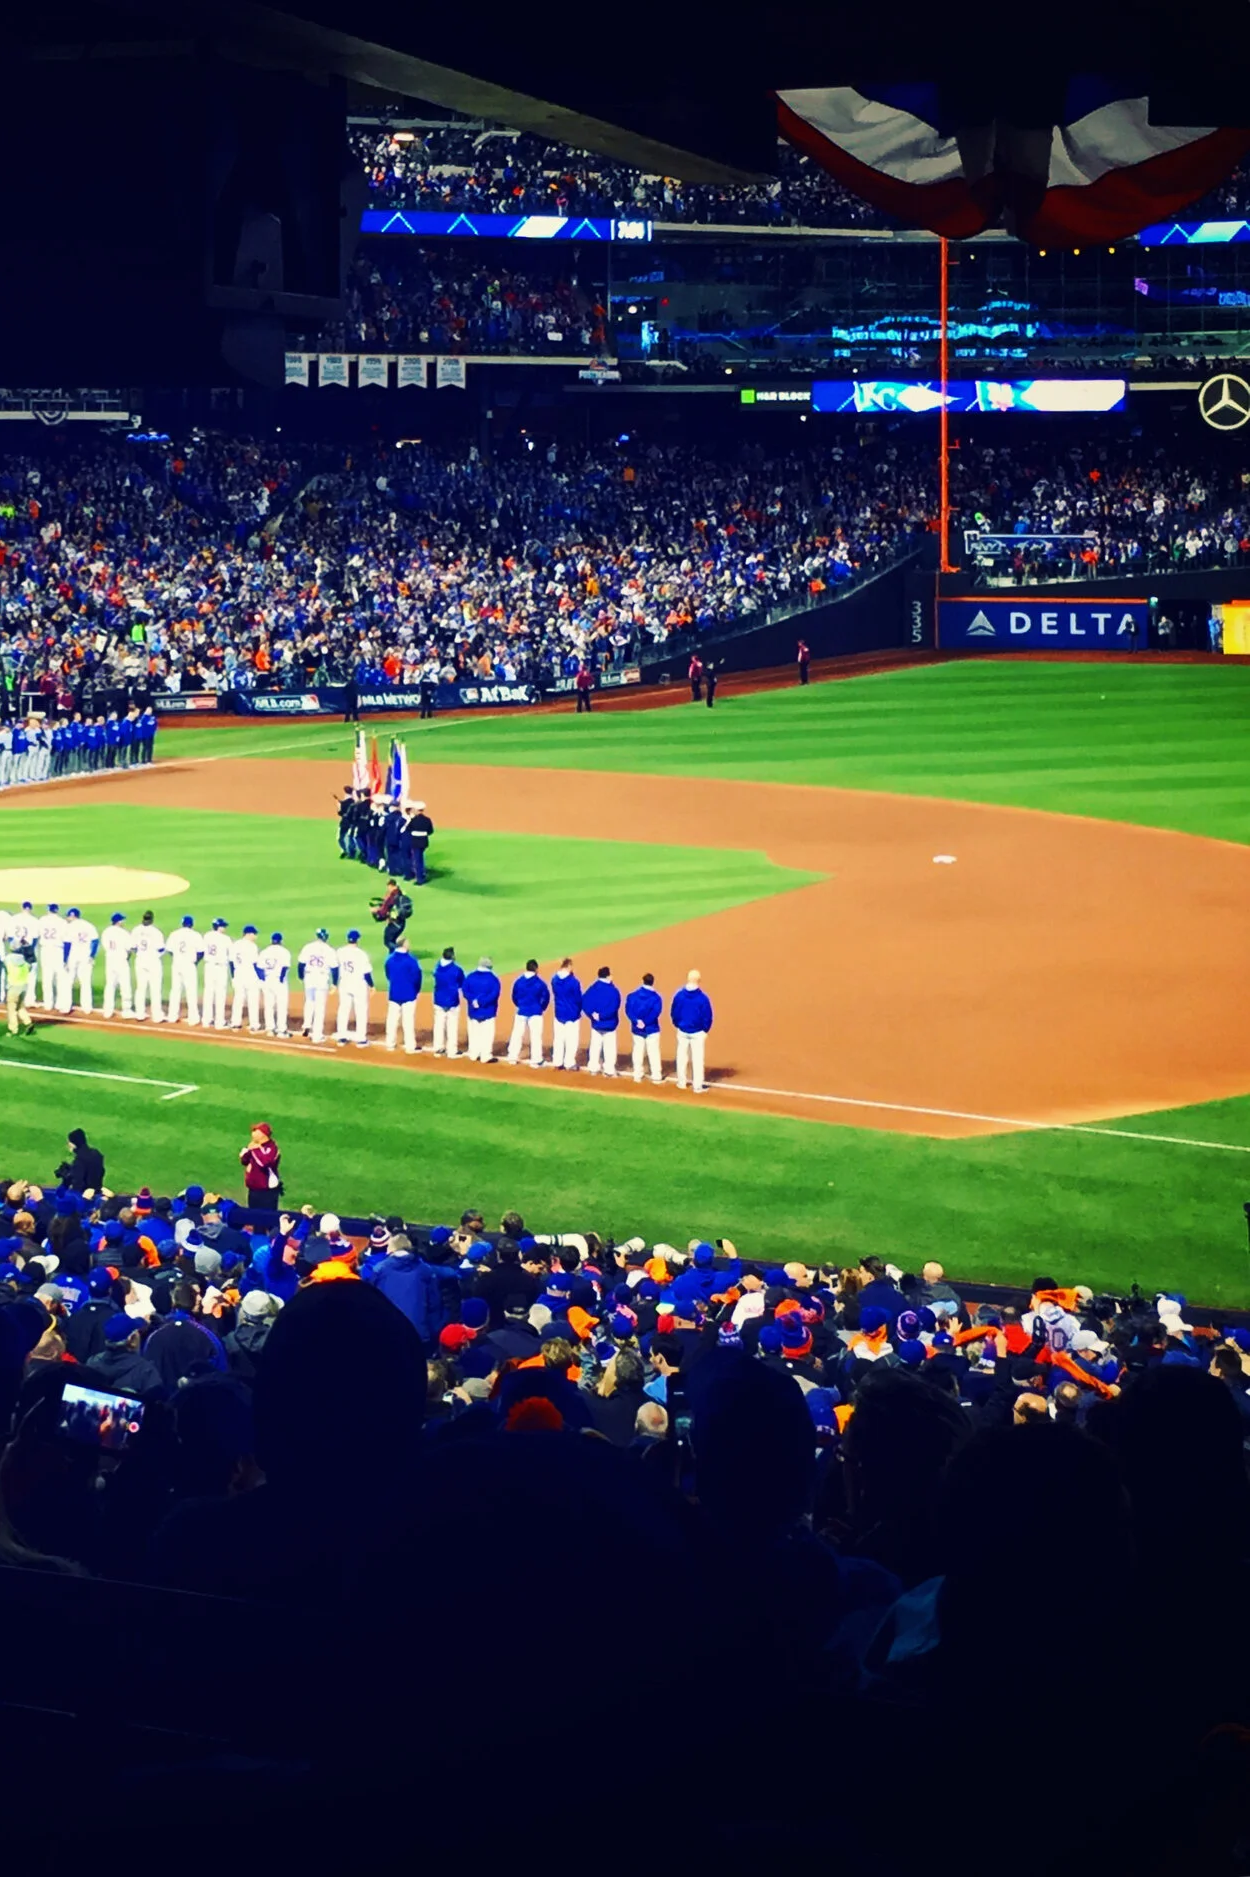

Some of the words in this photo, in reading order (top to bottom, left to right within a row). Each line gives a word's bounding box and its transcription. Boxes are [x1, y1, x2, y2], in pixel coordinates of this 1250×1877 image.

[778, 391, 812, 401] BLOCK
[911, 600, 922, 643] 335
[1009, 611, 1135, 635] DELTA
[43, 928, 58, 940] 22
[178, 940, 187, 954] 2
